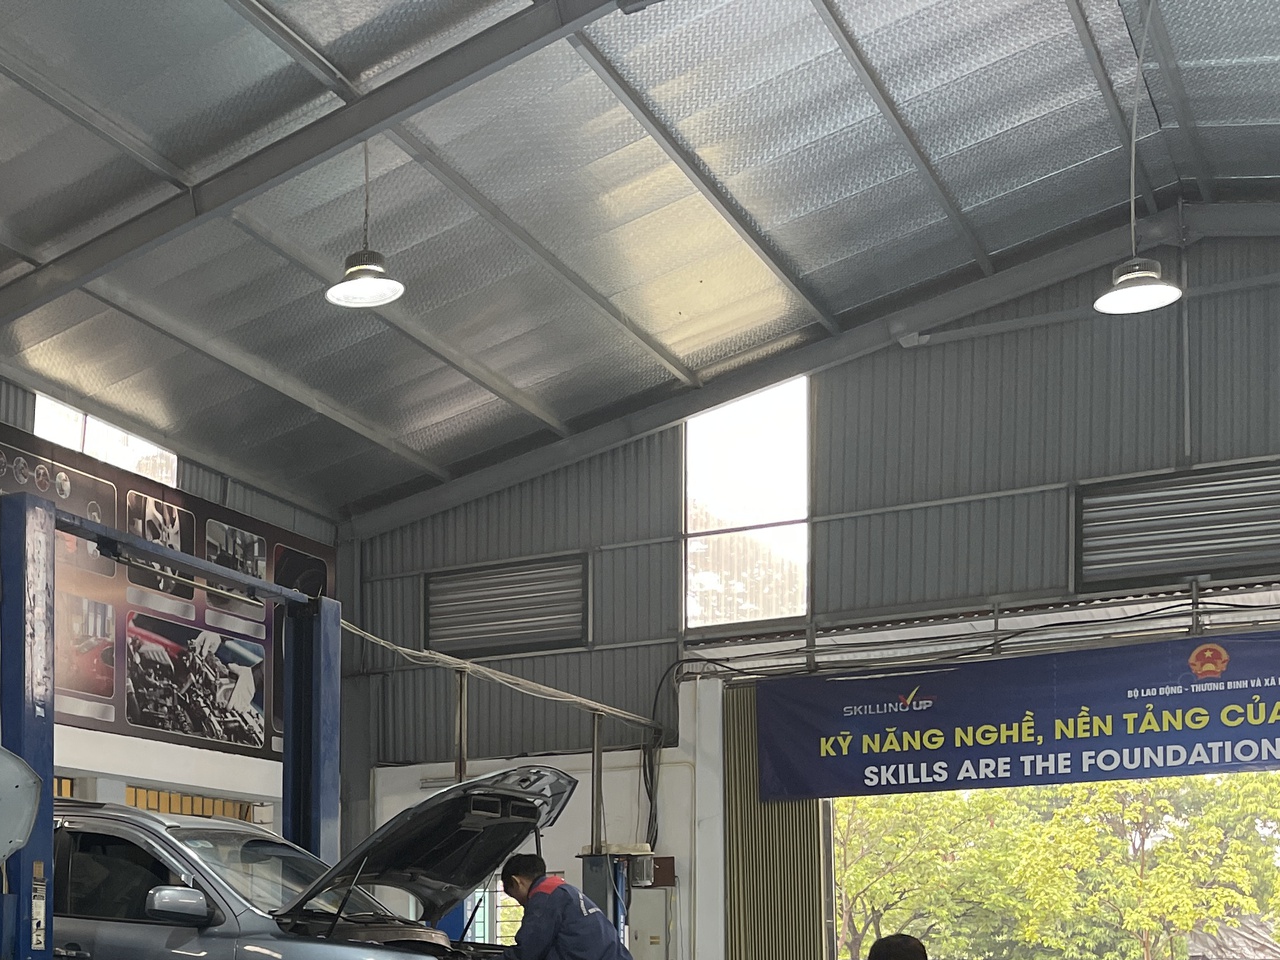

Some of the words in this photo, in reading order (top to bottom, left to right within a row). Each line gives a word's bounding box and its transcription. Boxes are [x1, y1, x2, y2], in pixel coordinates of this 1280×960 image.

[1141, 688, 1157, 697] LAO
[1250, 677, 1262, 688] VÀ
[912, 700, 933, 711] UP
[820, 731, 853, 757] KỸ
[862, 727, 945, 754] NĂNG
[955, 710, 1043, 748] NGHỀ,
[1055, 705, 1112, 740] NỀN
[1123, 703, 1210, 735] TẢNG
[1220, 695, 1280, 727] CỦA
[863, 761, 949, 787] SKILLS
[956, 757, 1011, 781] ARE
[1020, 753, 1071, 776] THE
[1082, 738, 1280, 772] FOUNDATION
